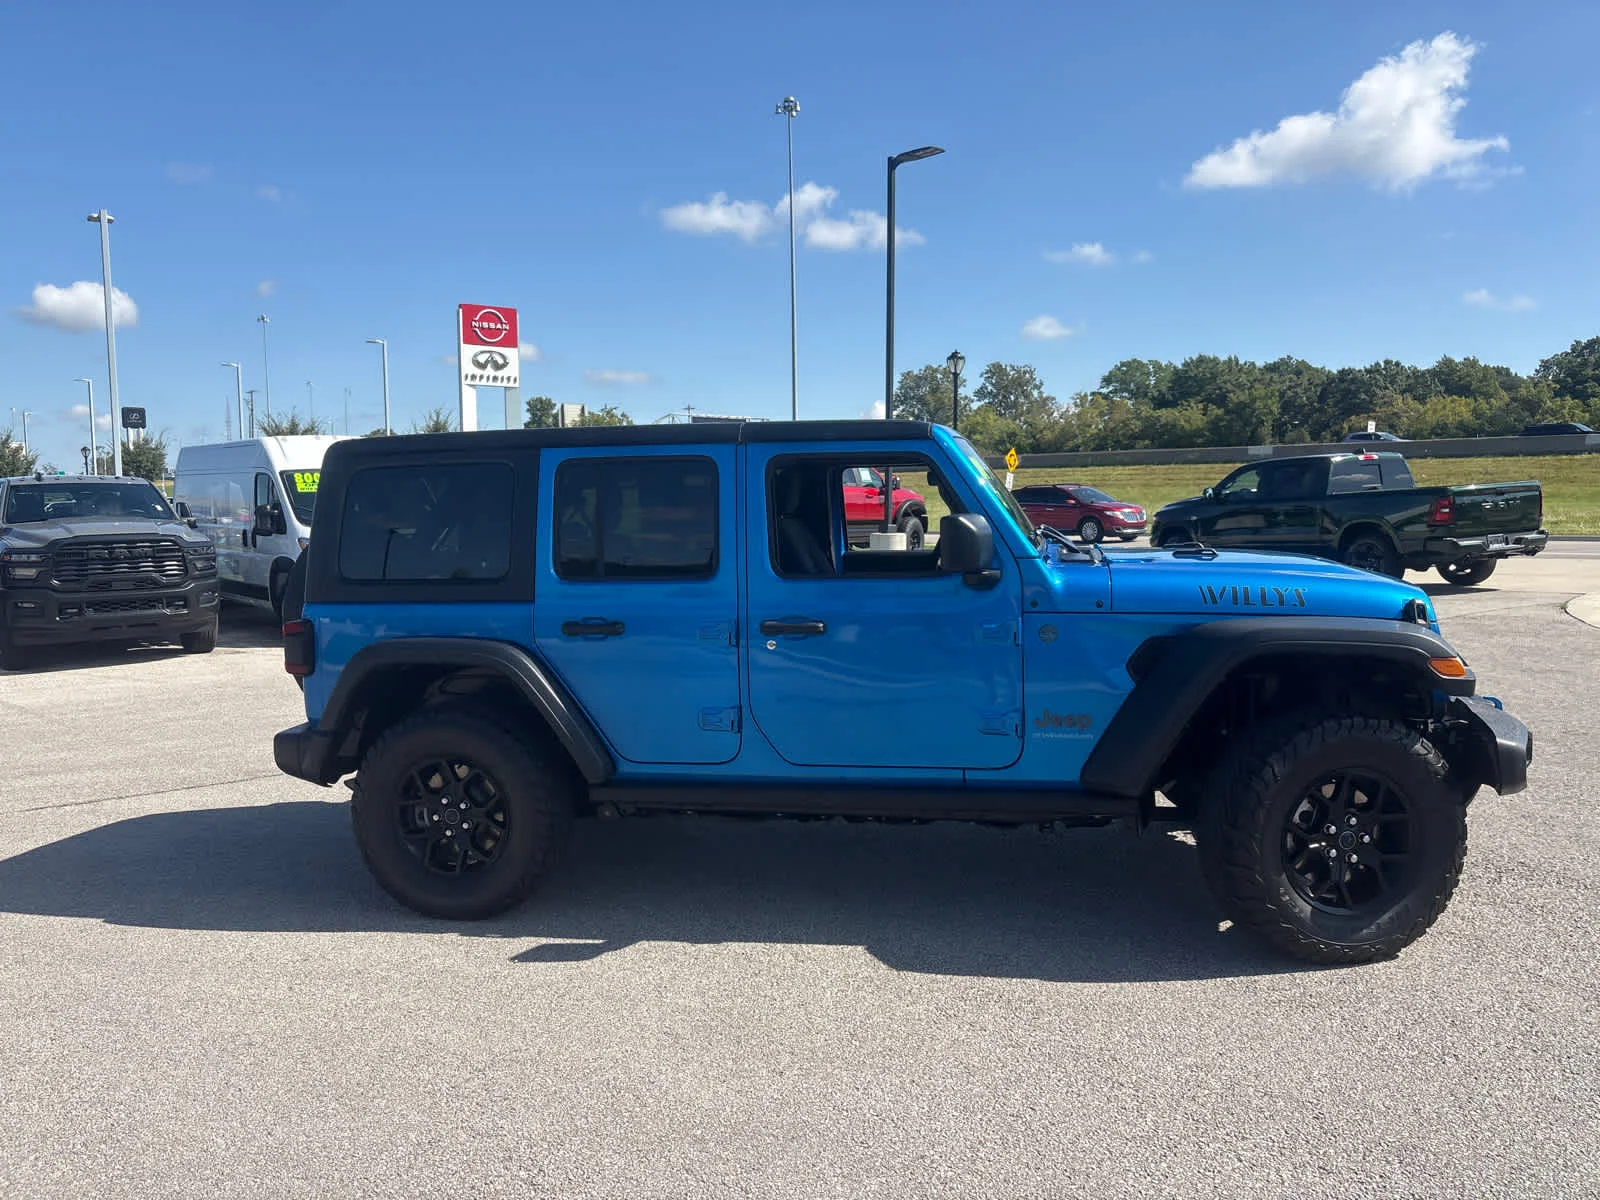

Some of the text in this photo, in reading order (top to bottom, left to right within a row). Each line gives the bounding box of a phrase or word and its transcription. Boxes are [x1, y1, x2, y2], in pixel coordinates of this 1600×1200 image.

[471, 321, 509, 330] NISSAN
[464, 373, 517, 384] INFINITI
[87, 548, 154, 561] RAM
[1198, 585, 1307, 607] WILLYS
[1035, 709, 1092, 731] Jeep
